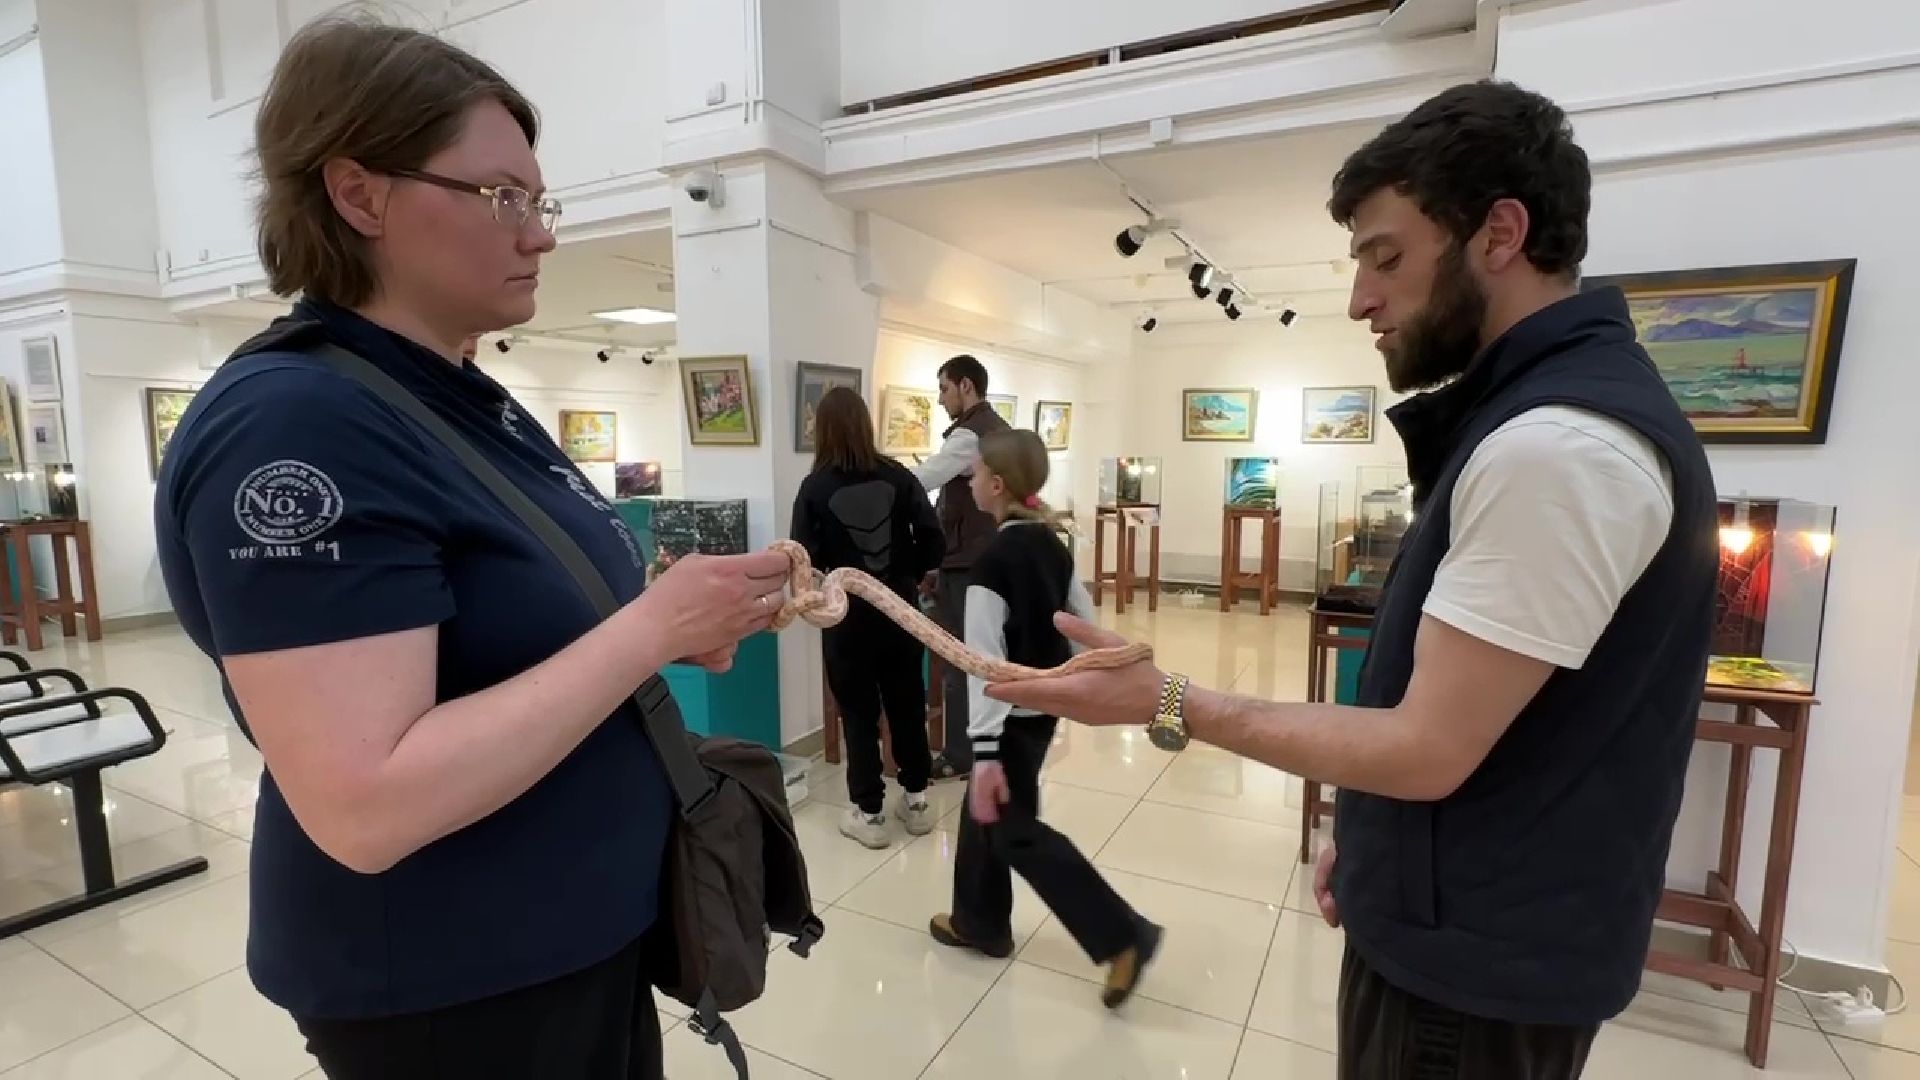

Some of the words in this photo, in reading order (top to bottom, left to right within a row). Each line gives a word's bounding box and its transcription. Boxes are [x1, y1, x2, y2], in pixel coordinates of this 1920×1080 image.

[240, 488, 304, 516] No.
[229, 546, 259, 559] YOU
[263, 545, 302, 558] ARE
[315, 540, 340, 561] #1
